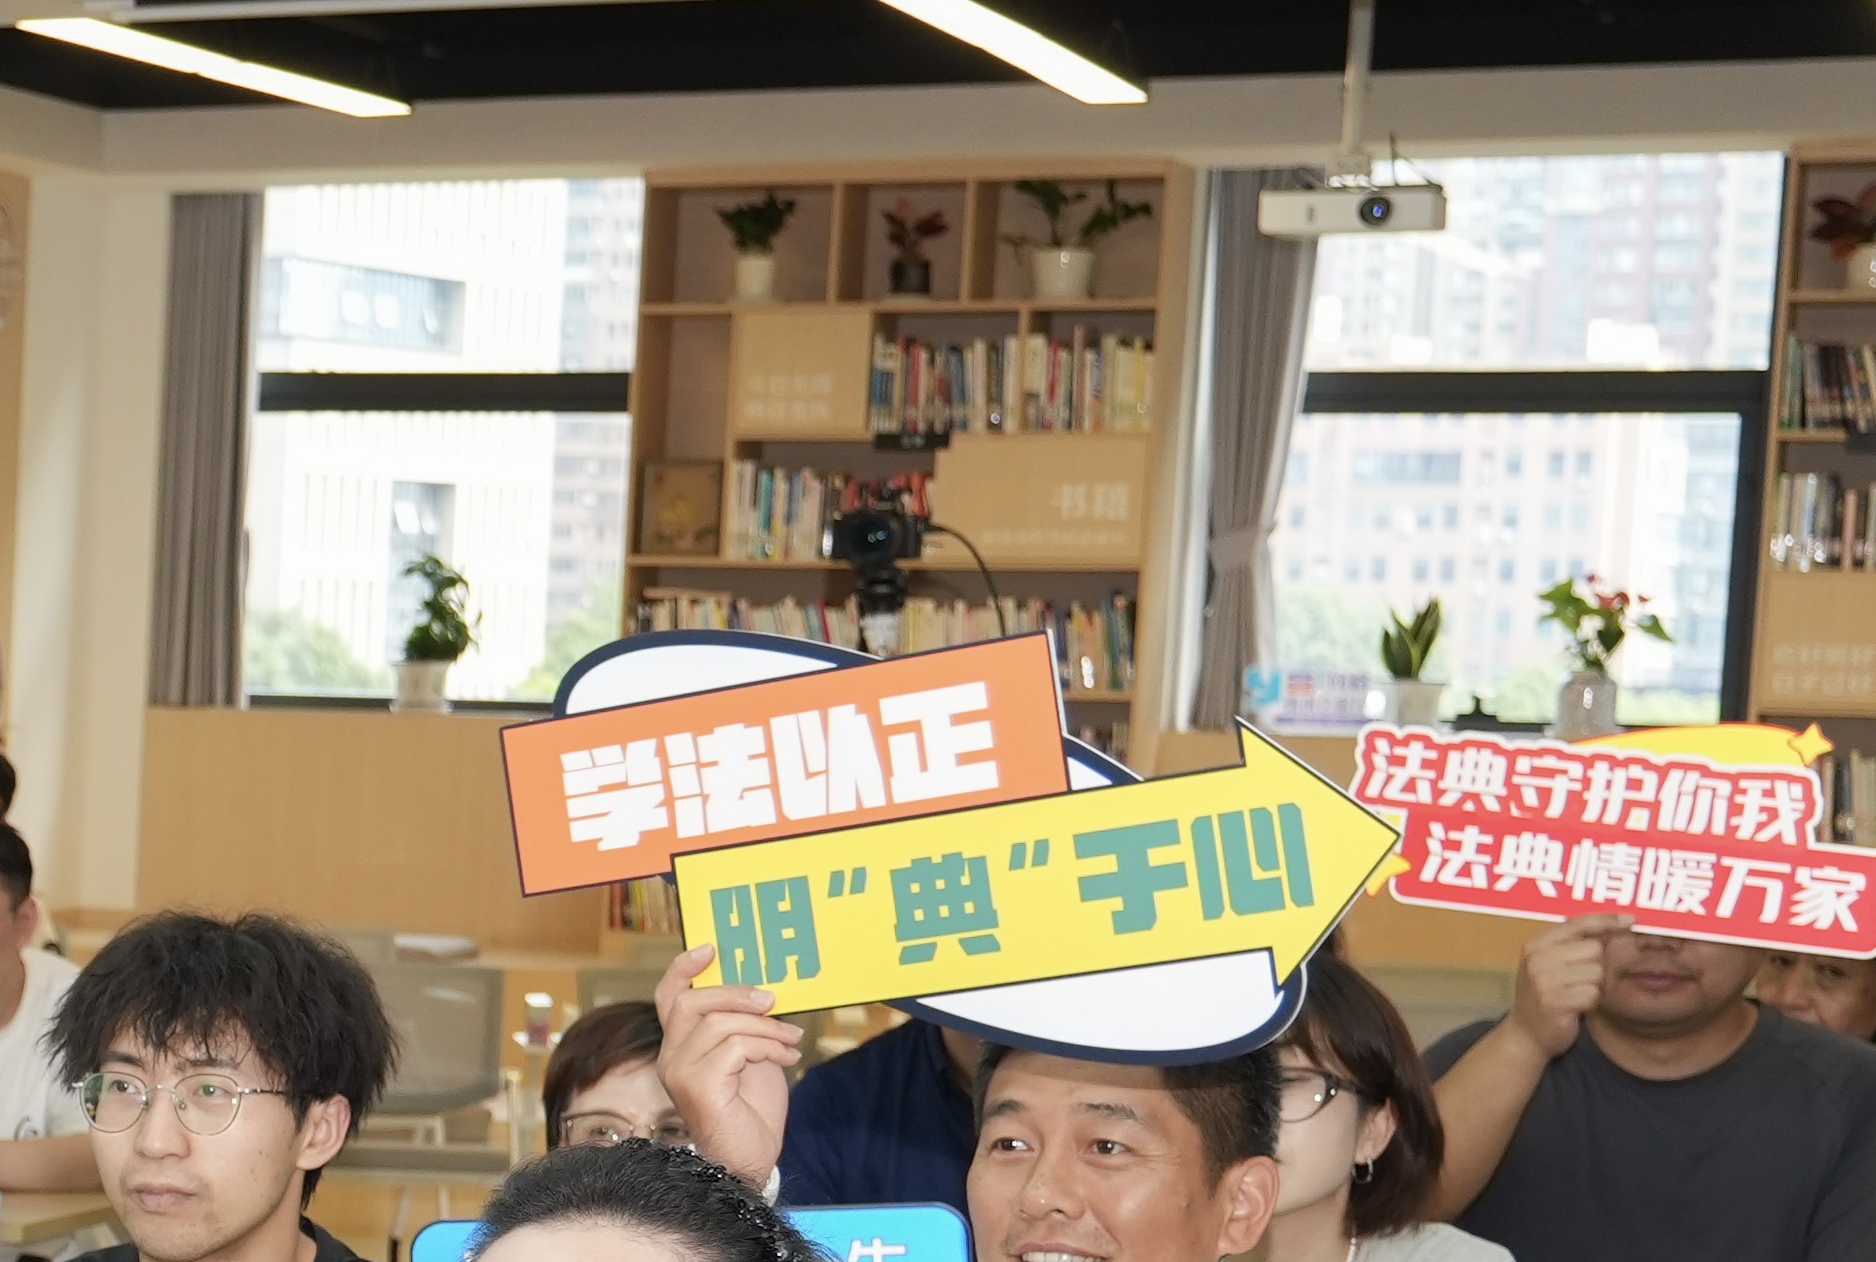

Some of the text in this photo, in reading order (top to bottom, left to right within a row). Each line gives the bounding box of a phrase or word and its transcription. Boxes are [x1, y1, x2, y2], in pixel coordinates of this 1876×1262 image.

[559, 680, 1001, 852] 学法以正
[1364, 735, 1807, 846] 法典守护你我
[1419, 820, 1869, 933] 法典情暖万家
